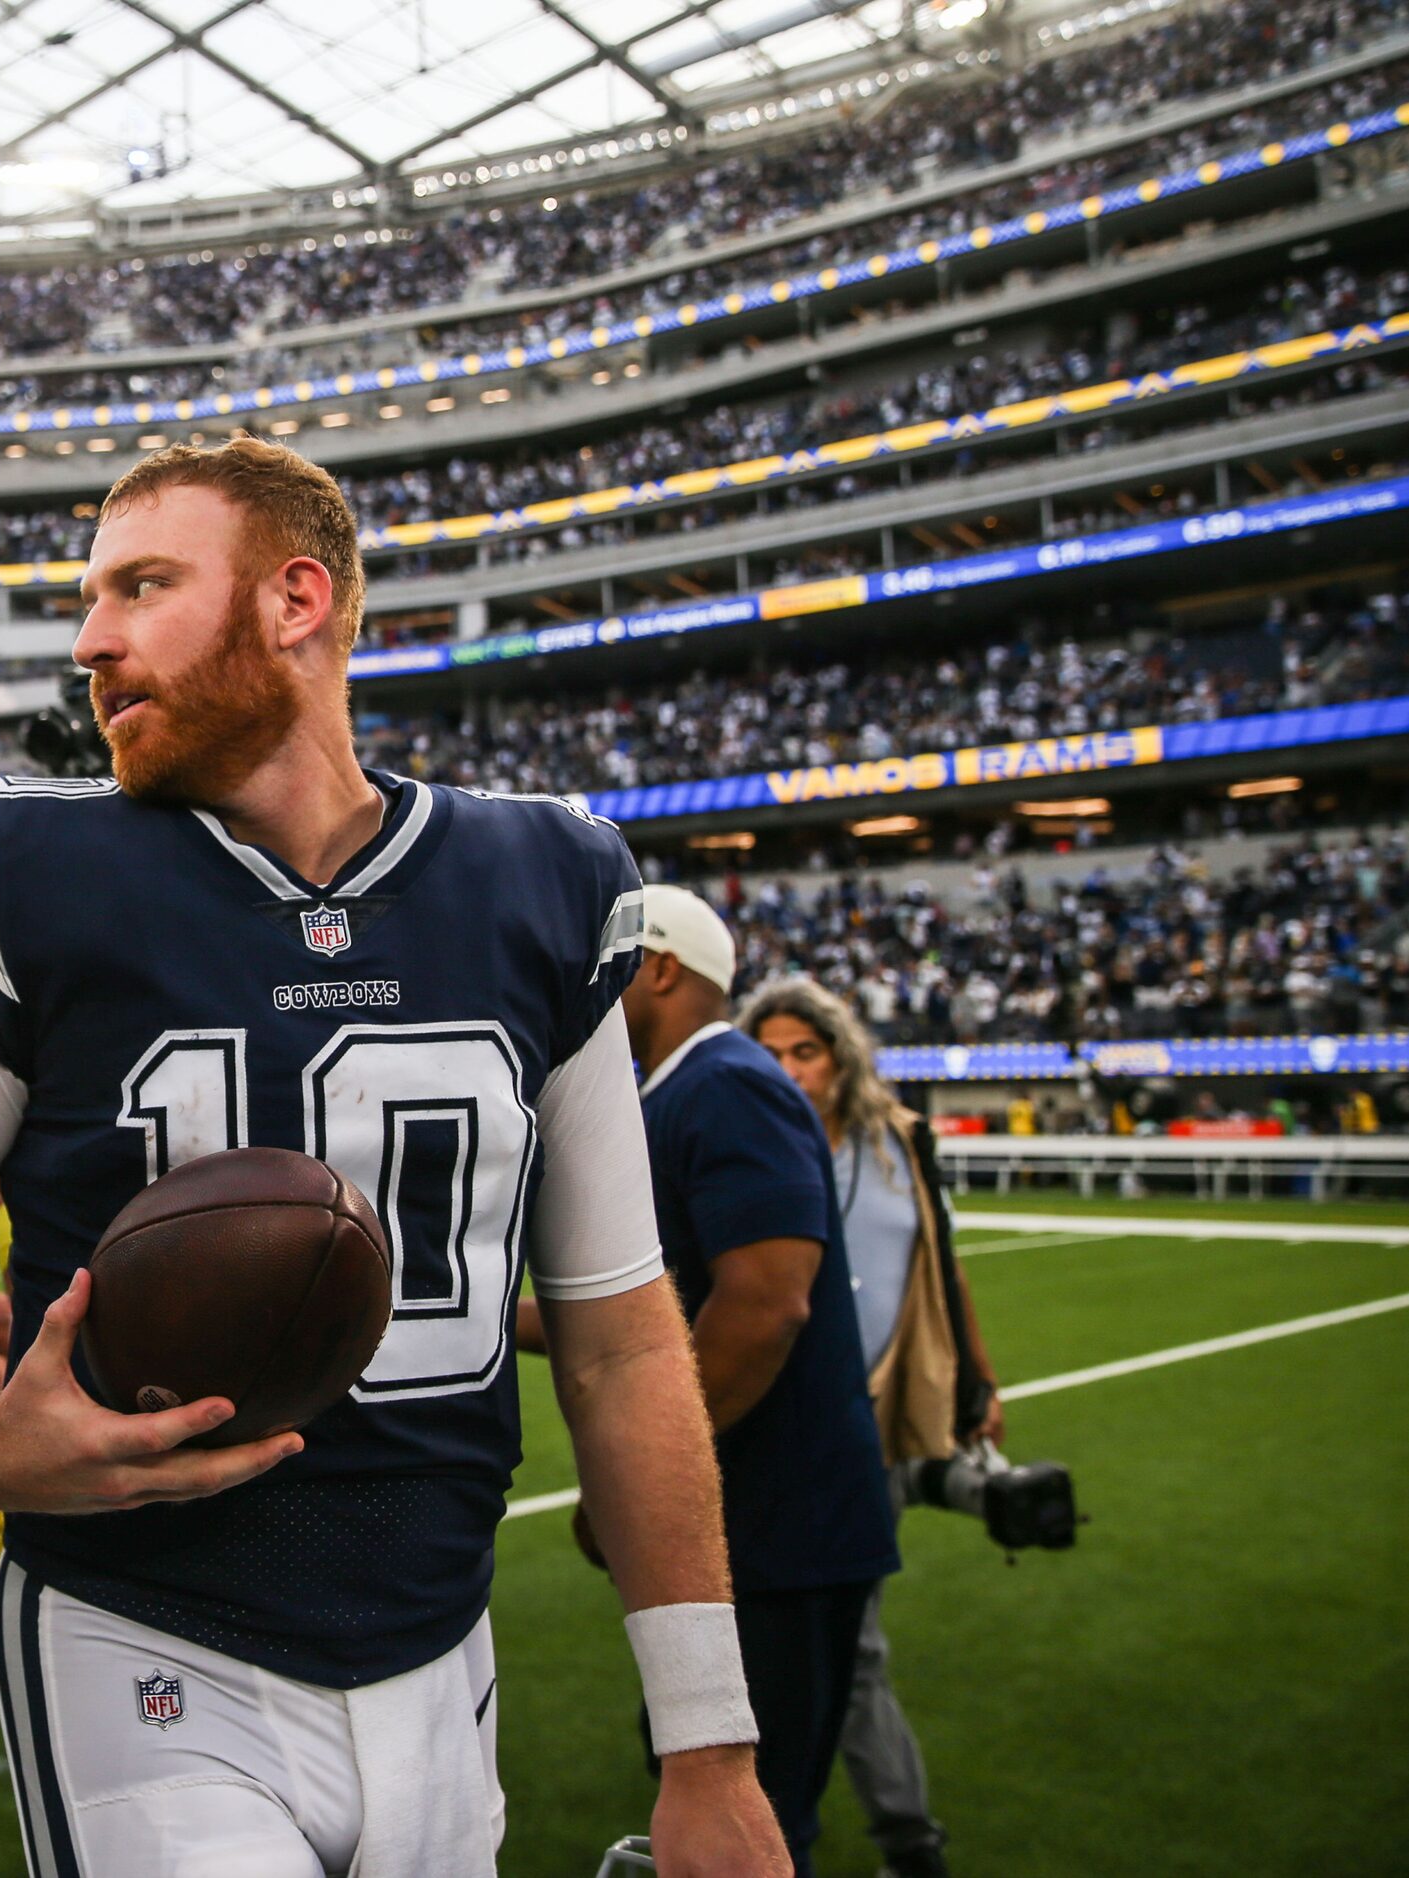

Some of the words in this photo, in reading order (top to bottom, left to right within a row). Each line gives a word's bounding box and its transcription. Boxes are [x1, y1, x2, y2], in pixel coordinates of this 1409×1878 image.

[766, 752, 948, 803] VAMOS
[311, 926, 344, 947] NFL
[272, 980, 401, 1011] COWBOYS
[144, 1695, 180, 1718] NFL
